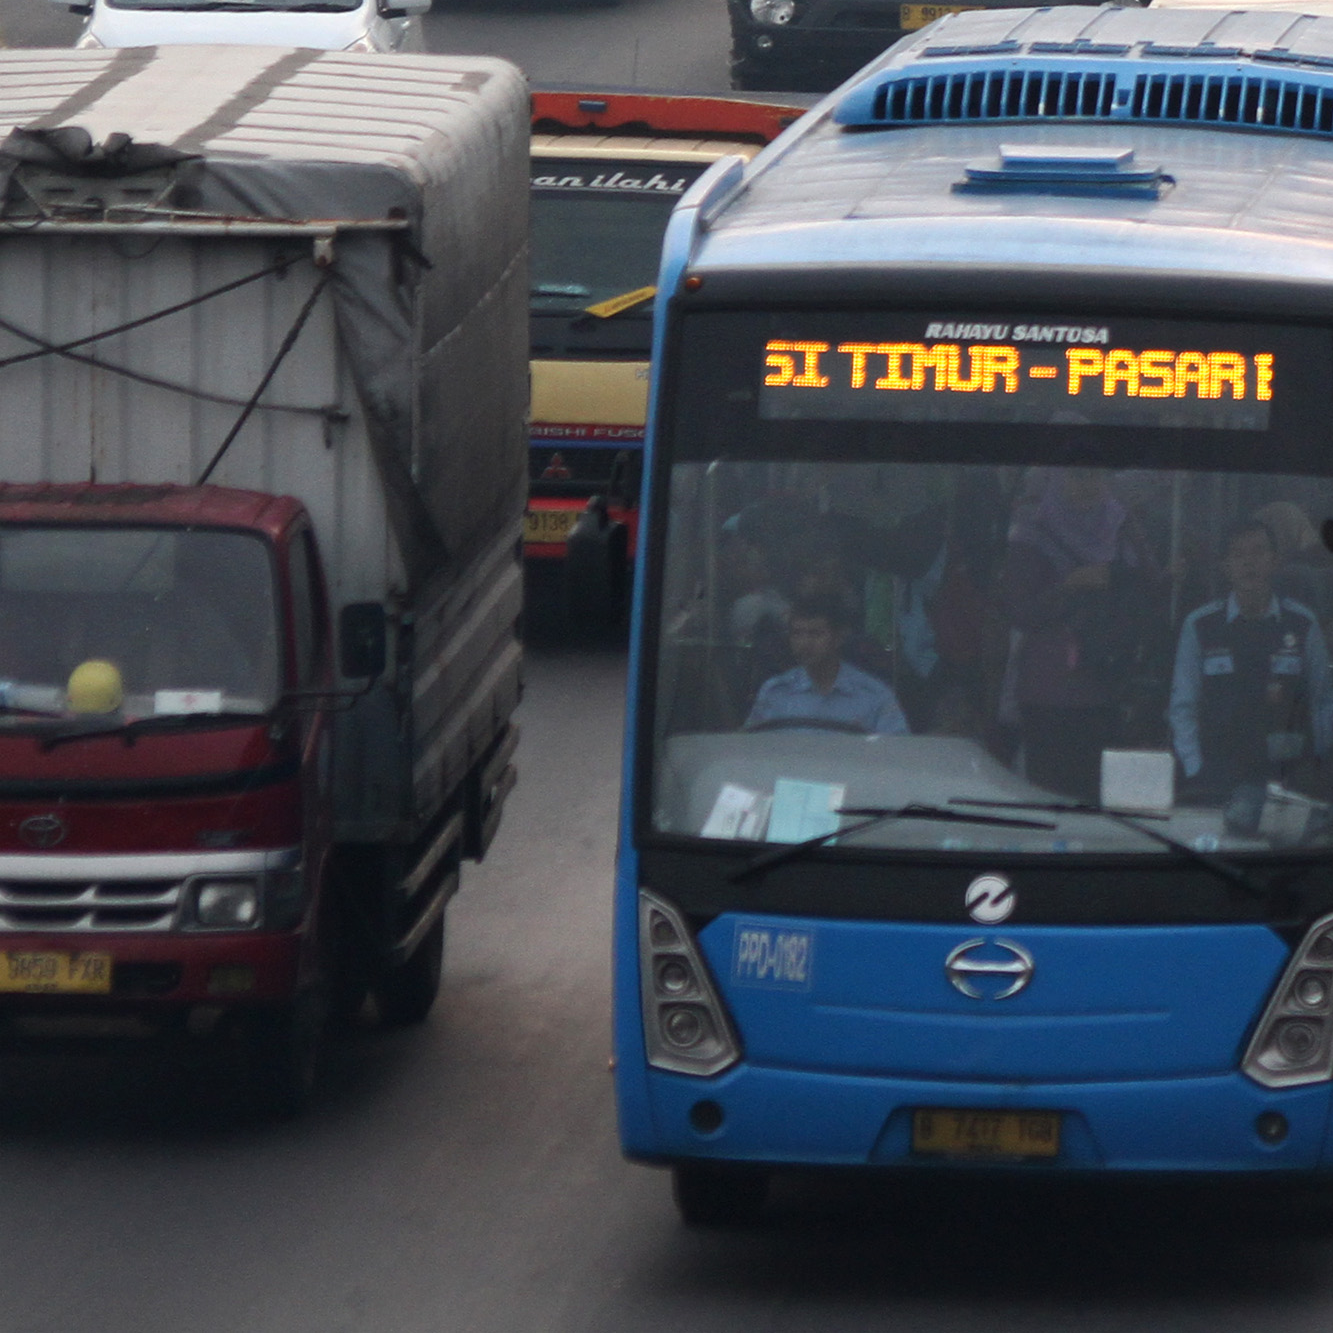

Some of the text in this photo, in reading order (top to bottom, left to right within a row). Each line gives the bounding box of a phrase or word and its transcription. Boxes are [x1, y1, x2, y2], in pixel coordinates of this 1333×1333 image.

[530, 171, 686, 192] an ilahi
[925, 321, 1110, 344] RAHAYU SANTOSA
[837, 342, 1019, 394] TIMUR
[1065, 347, 1247, 401] PASAR
